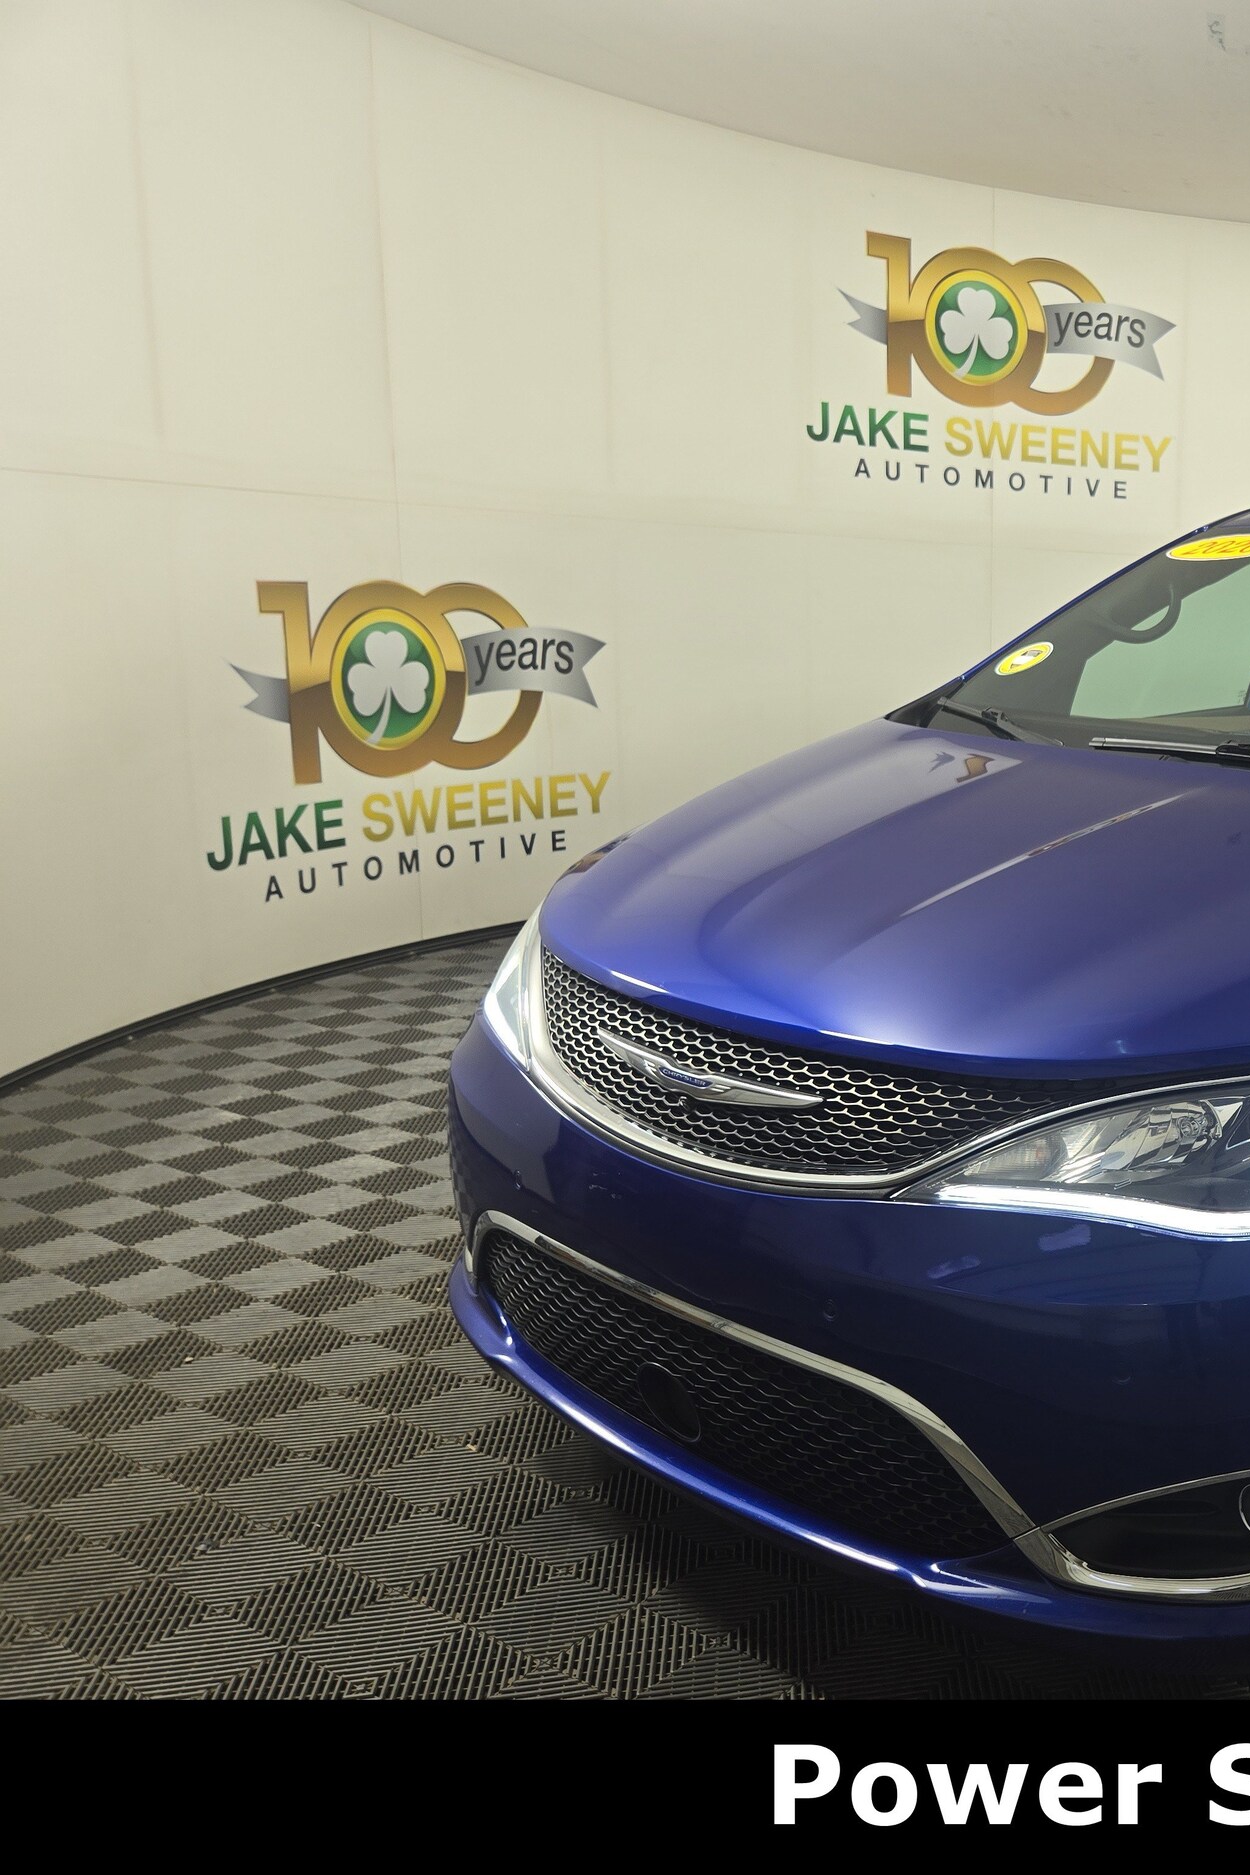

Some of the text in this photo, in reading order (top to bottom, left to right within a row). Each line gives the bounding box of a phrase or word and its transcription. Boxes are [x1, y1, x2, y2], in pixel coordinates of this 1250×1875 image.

[866, 230, 1146, 416] 100 years
[806, 401, 1172, 473] JAKE SWEENEY
[854, 458, 1128, 499] AUTOMOTIVE
[256, 580, 574, 785] 100 years
[206, 771, 611, 872] JAKE SWEENEY
[264, 829, 567, 902] AUTOMOTIVE
